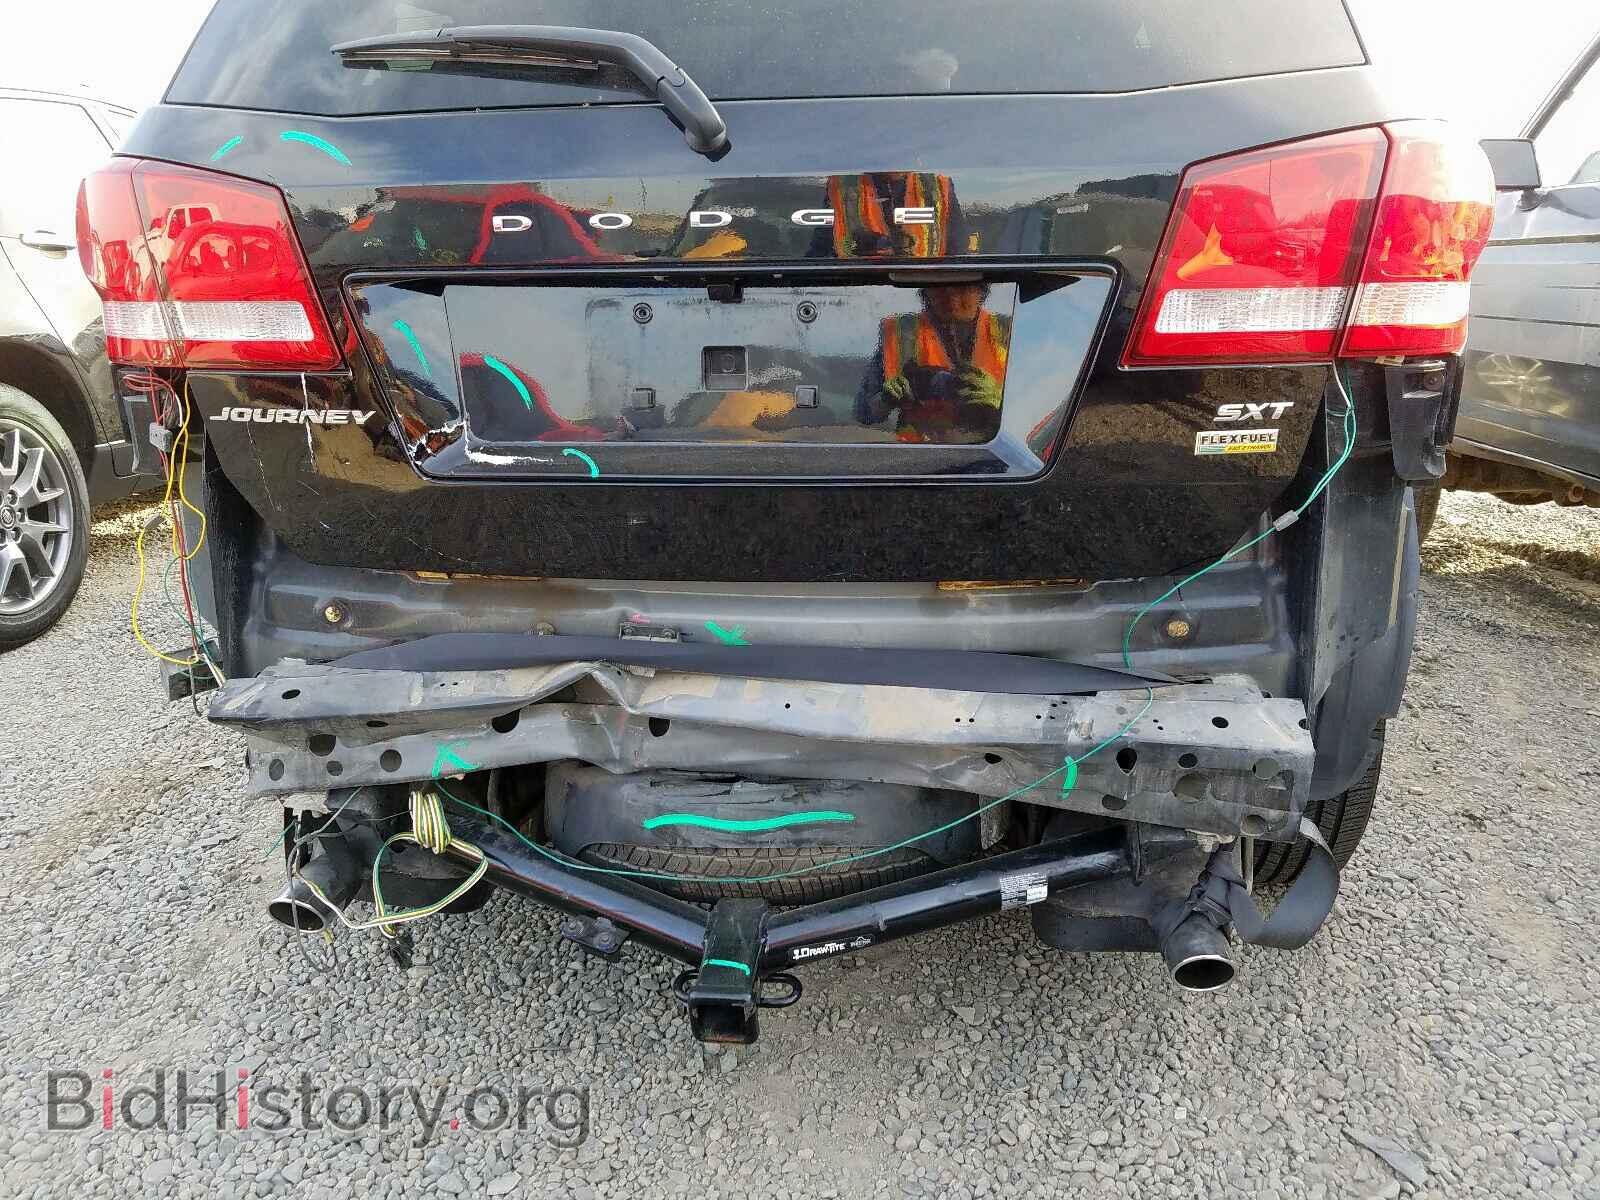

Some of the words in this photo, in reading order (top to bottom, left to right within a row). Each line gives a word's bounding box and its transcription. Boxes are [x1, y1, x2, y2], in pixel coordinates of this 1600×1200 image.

[493, 207, 935, 232] DODGE
[209, 406, 377, 424] JOURNEY
[1213, 402, 1295, 421] SXT
